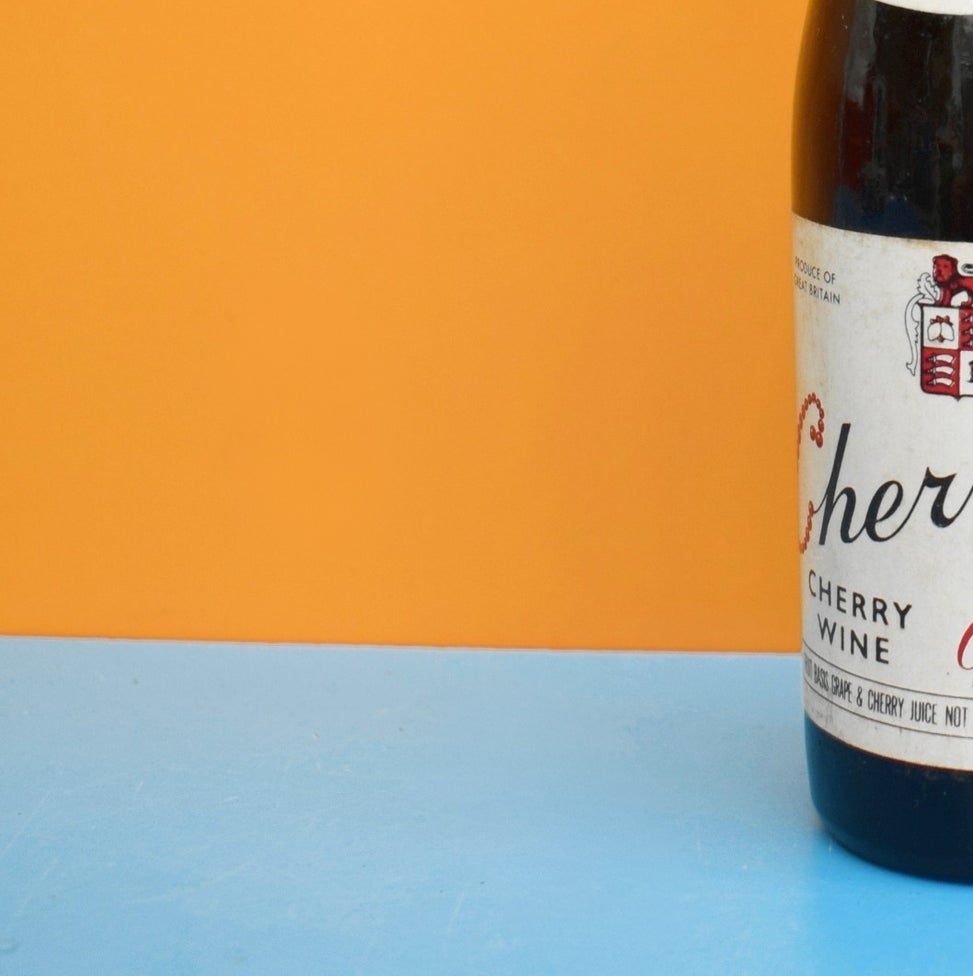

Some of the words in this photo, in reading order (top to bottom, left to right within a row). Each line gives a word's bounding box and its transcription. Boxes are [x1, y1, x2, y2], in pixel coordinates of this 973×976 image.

[809, 283, 841, 305] BRITAIN
[823, 270, 836, 285] OF
[808, 569, 913, 630] CHERRY
[816, 613, 890, 665] WINE
[814, 663, 830, 692] BASIS
[831, 674, 853, 704] GRAPE
[856, 685, 864, 708] &
[867, 689, 905, 719] CHERRY
[910, 699, 938, 725] JUICE
[945, 705, 968, 729] NOT
